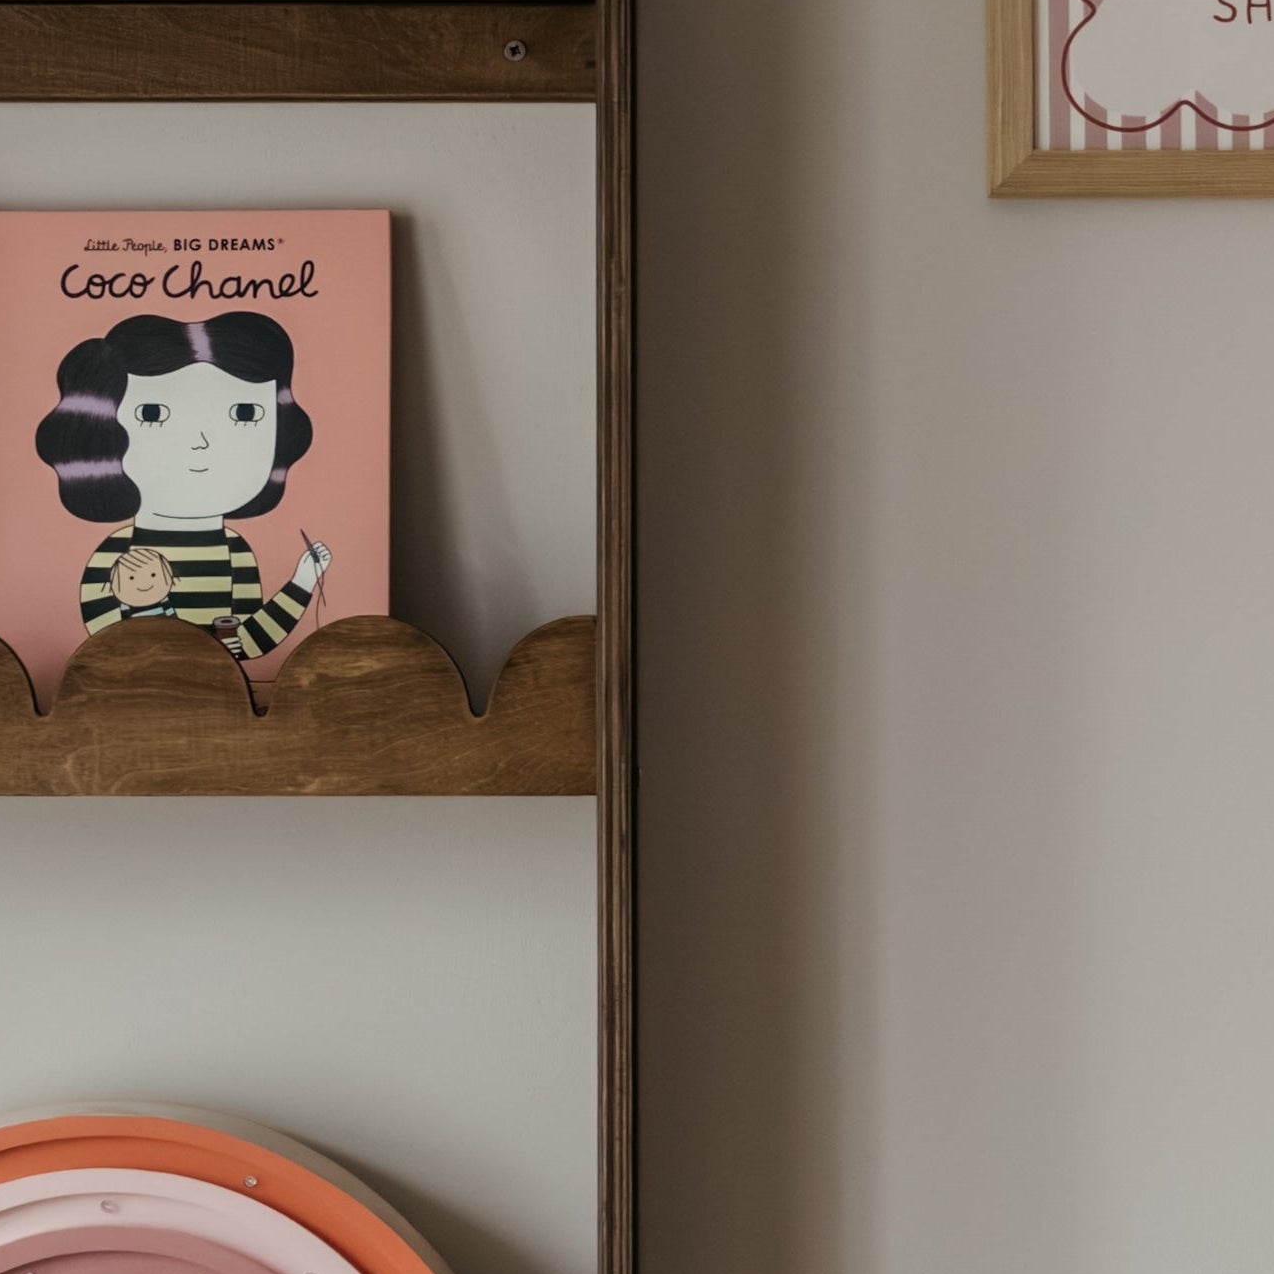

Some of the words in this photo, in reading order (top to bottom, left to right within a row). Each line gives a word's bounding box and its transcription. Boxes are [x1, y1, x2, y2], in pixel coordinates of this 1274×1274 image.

[84, 238, 120, 252] Little
[122, 238, 168, 257] People,
[173, 238, 202, 251] BIG
[60, 263, 156, 300] Coco
[161, 260, 319, 300] Chanel
